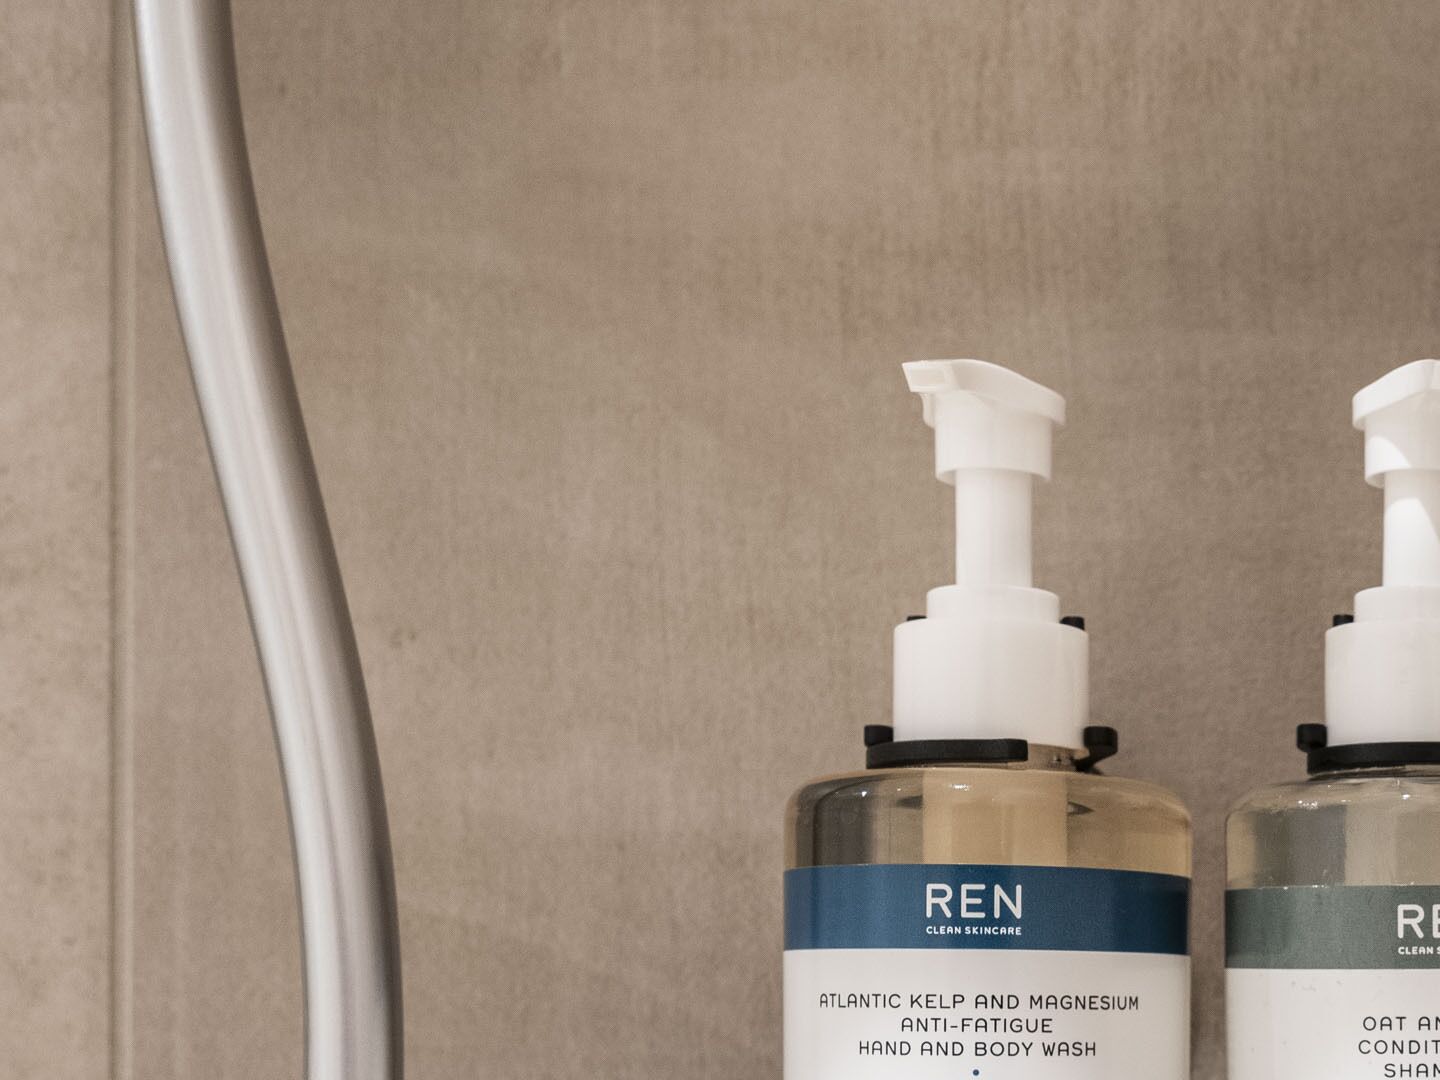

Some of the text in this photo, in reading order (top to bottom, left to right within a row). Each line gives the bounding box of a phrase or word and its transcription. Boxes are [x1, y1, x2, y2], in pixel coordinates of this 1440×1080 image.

[926, 883, 1022, 919] REN
[926, 925, 1022, 936] CLEAN SKINCARE
[1397, 946, 1434, 955] CLEAN
[819, 993, 1139, 1011] ATLANTIC KELP AND MAGNESIUM
[901, 1017, 1053, 1033] ANTI-FATIGUE
[1362, 1016, 1407, 1031] OAT
[859, 1041, 1096, 1057] HAND AND BODY WASH
